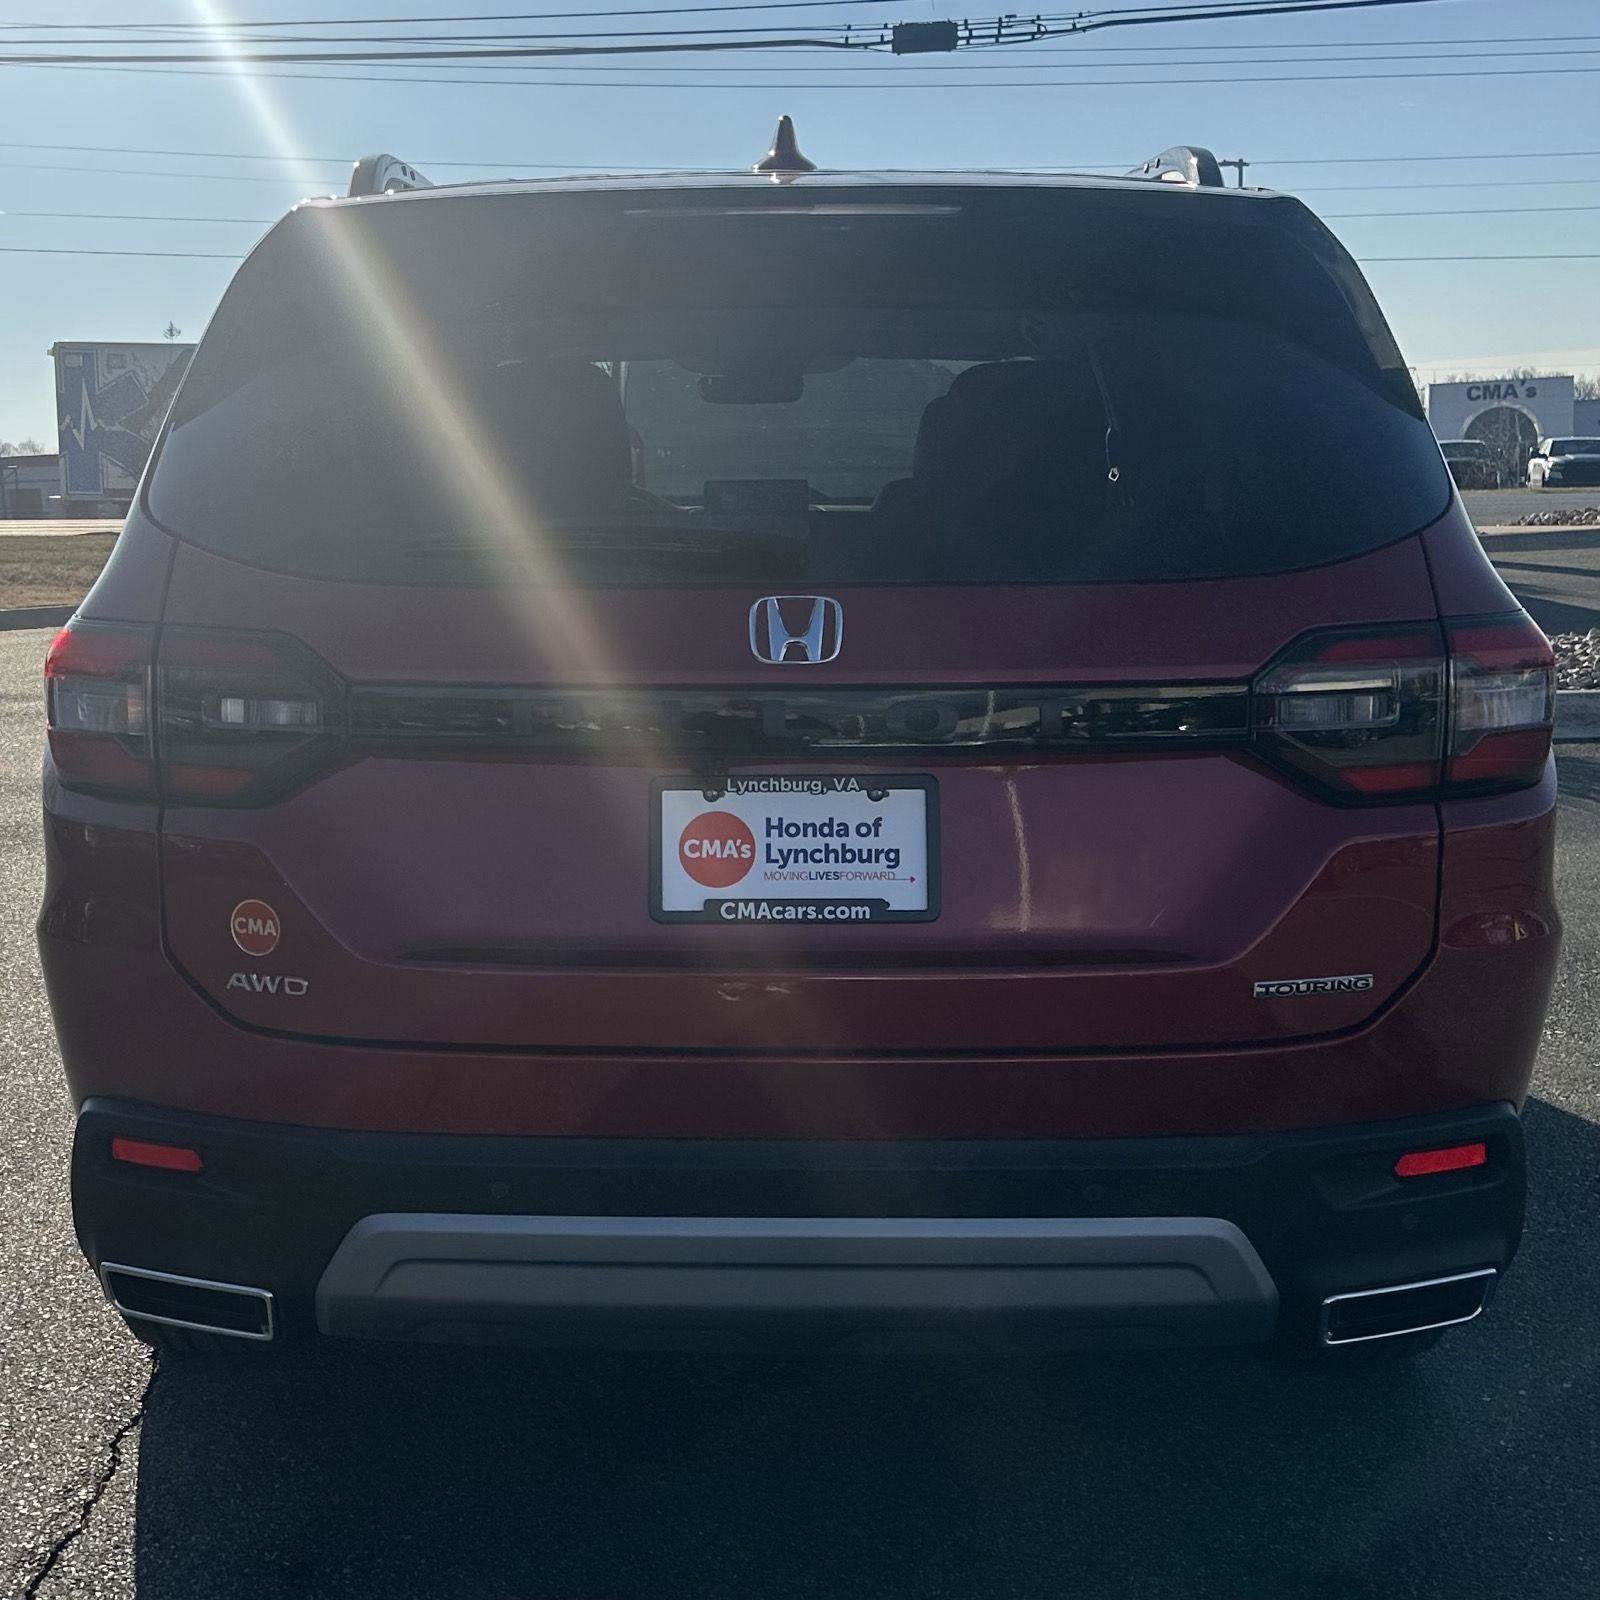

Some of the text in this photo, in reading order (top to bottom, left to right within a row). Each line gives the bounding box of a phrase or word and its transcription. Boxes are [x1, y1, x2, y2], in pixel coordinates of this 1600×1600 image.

[1466, 380, 1537, 401] CMA's
[726, 778, 861, 794] Lynchburg, VA
[765, 817, 882, 838] Honda of
[683, 838, 752, 859] CMA's
[765, 843, 901, 868] Lynchburg
[720, 902, 871, 920] CMAcars.com
[234, 917, 277, 936] CMA
[226, 972, 309, 996] AWD
[1253, 974, 1374, 998] TOURING
